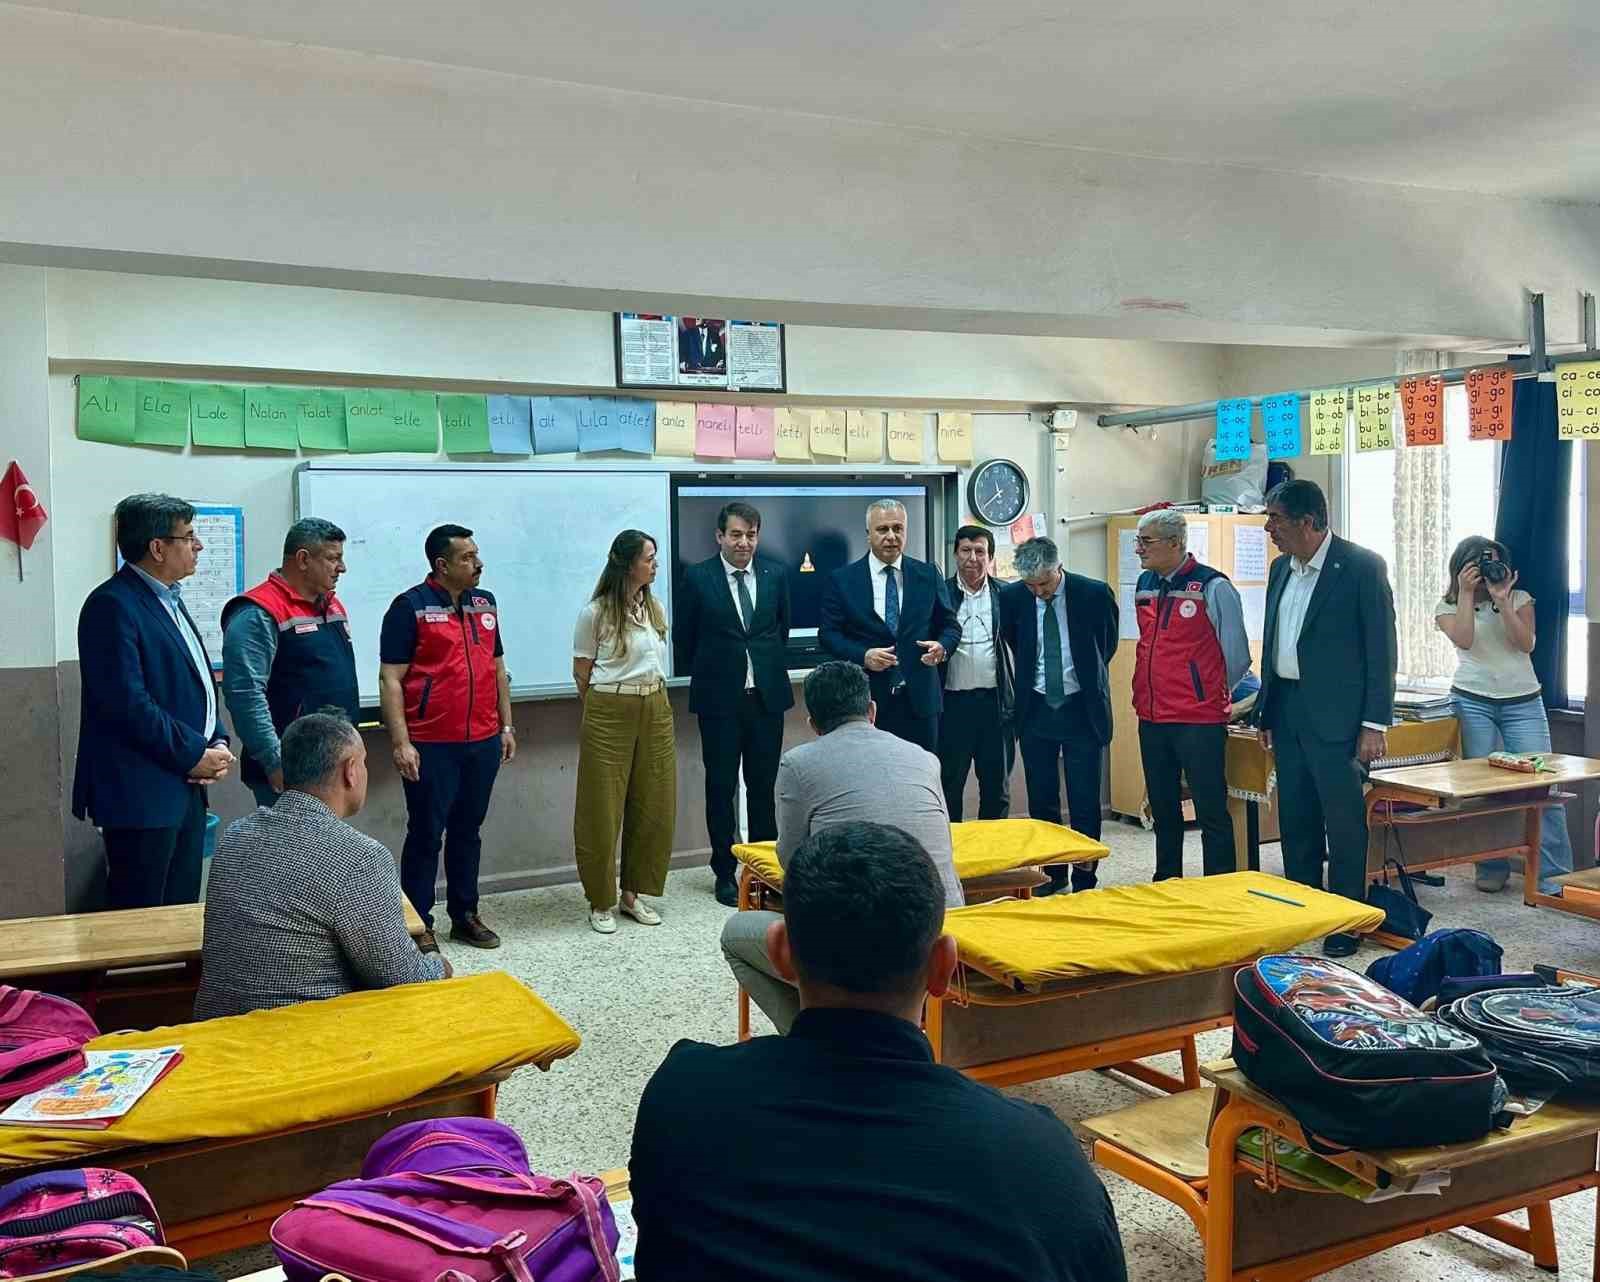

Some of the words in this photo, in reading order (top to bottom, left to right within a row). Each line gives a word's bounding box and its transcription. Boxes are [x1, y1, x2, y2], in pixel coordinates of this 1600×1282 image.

[1469, 373, 1484, 388] ga
[1491, 371, 1506, 386] ge
[1560, 372, 1577, 381] ca
[1332, 391, 1345, 405] eb
[1358, 388, 1372, 403] ba
[1377, 386, 1390, 401] be
[1489, 387, 1505, 402] go
[1561, 385, 1573, 398] ci
[143, 395, 172, 414] Ela
[196, 403, 229, 420] Lale
[249, 400, 288, 420] Nalan
[297, 402, 333, 419] Talat
[1377, 402, 1390, 416] bo
[1560, 407, 1574, 416] cu
[391, 407, 422, 427] elle
[1315, 421, 1326, 436] ub
[1359, 420, 1372, 434] bu
[1488, 419, 1504, 437] gö
[1561, 423, 1573, 435] cü
[1582, 422, 1600, 434] cö
[888, 430, 917, 441] anne
